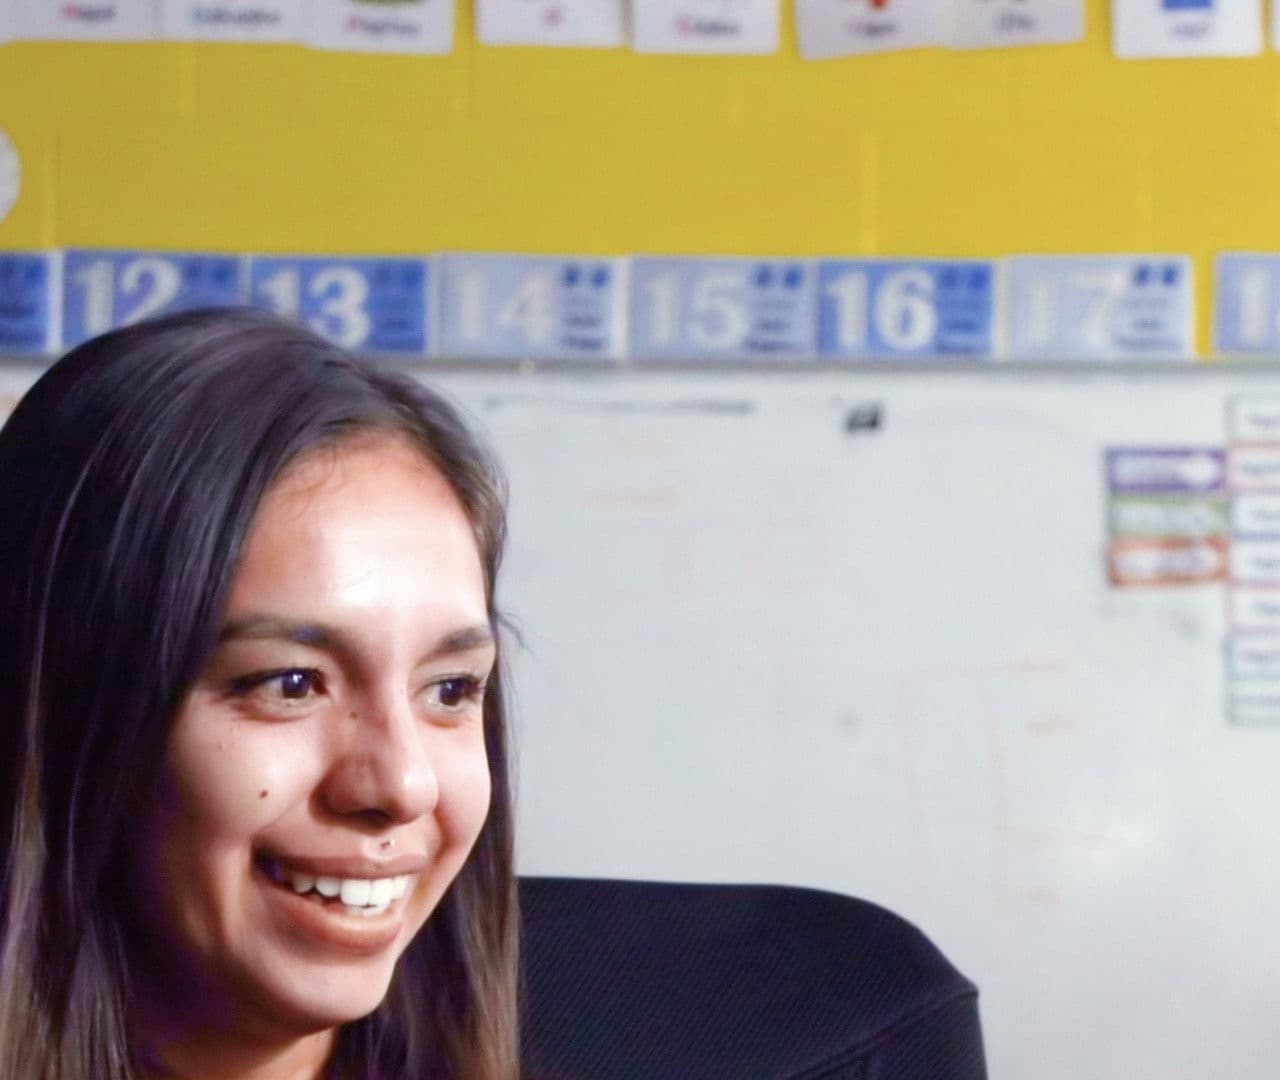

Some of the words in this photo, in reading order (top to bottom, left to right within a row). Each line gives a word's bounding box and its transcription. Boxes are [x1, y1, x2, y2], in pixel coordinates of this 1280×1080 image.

[75, 258, 181, 337] 12
[264, 266, 371, 351] 13
[455, 267, 554, 343] 14
[646, 269, 750, 350] 15
[827, 269, 938, 351] 16
